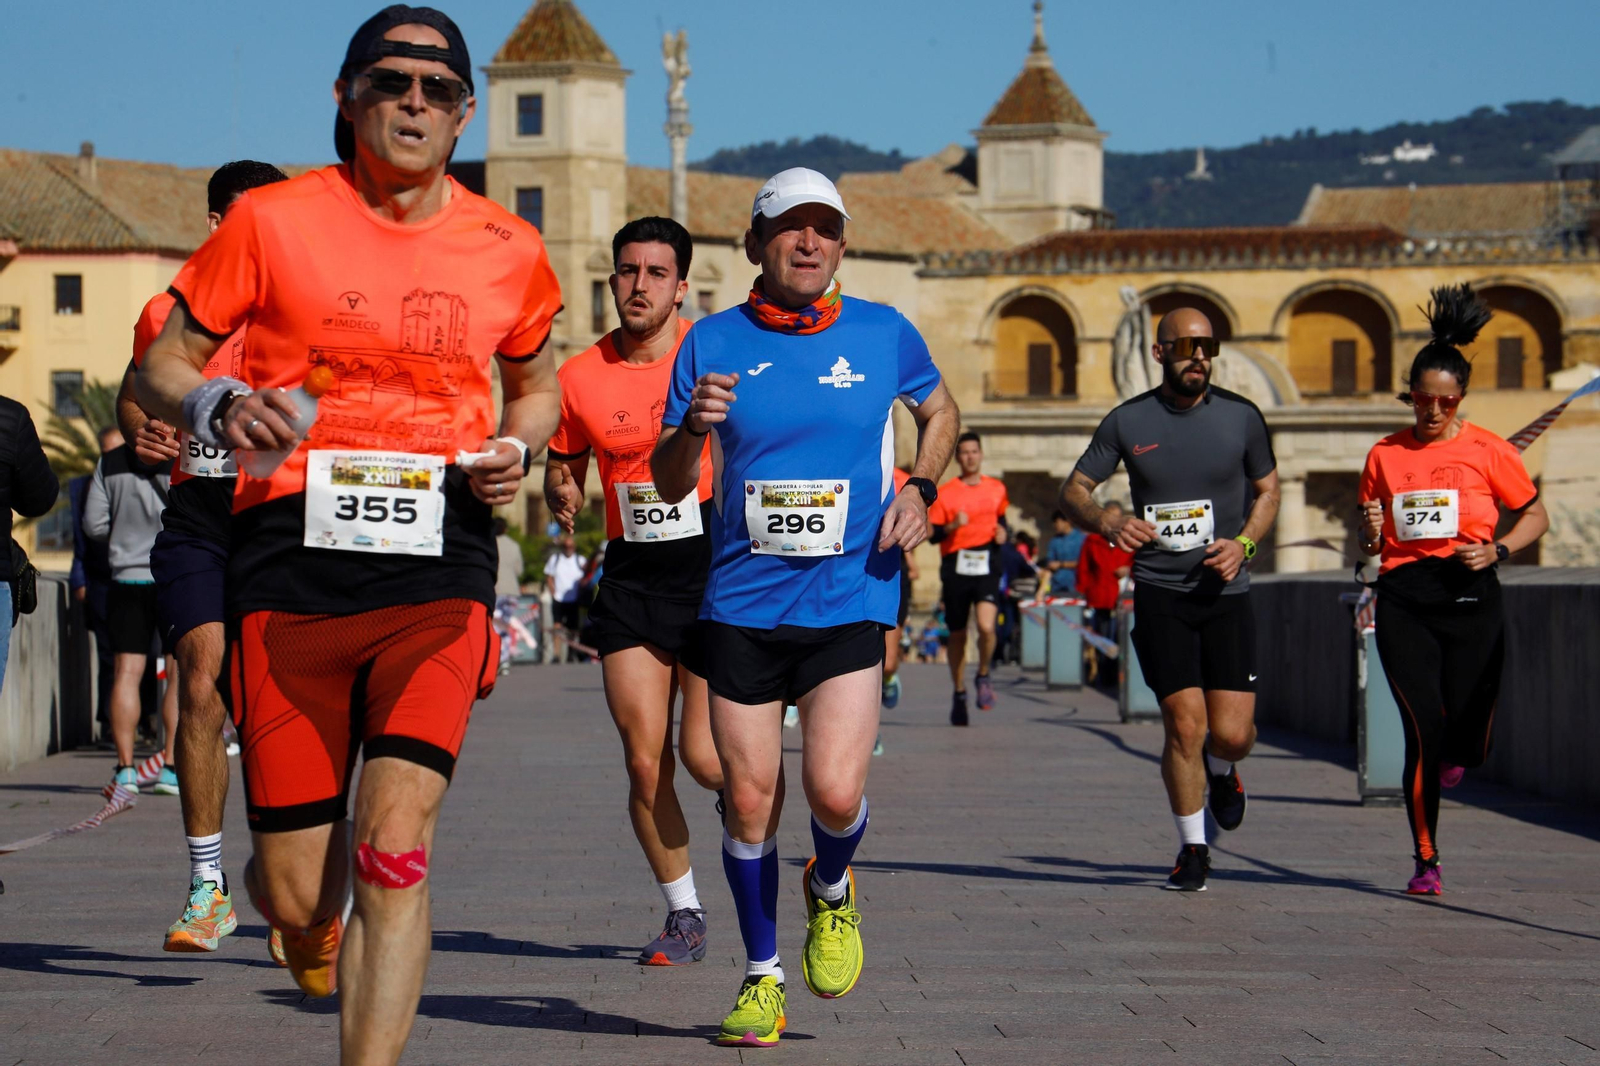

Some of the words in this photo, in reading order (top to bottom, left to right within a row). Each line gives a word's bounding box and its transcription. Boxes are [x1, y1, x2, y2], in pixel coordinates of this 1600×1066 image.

[315, 413, 382, 429] ARRERA
[363, 471, 401, 485] XXIII
[783, 495, 812, 505] XXIII
[335, 494, 418, 524] 355
[633, 505, 682, 525] 504
[767, 513, 826, 534] 296
[1405, 511, 1442, 526] 374
[1161, 522, 1199, 538] 444
